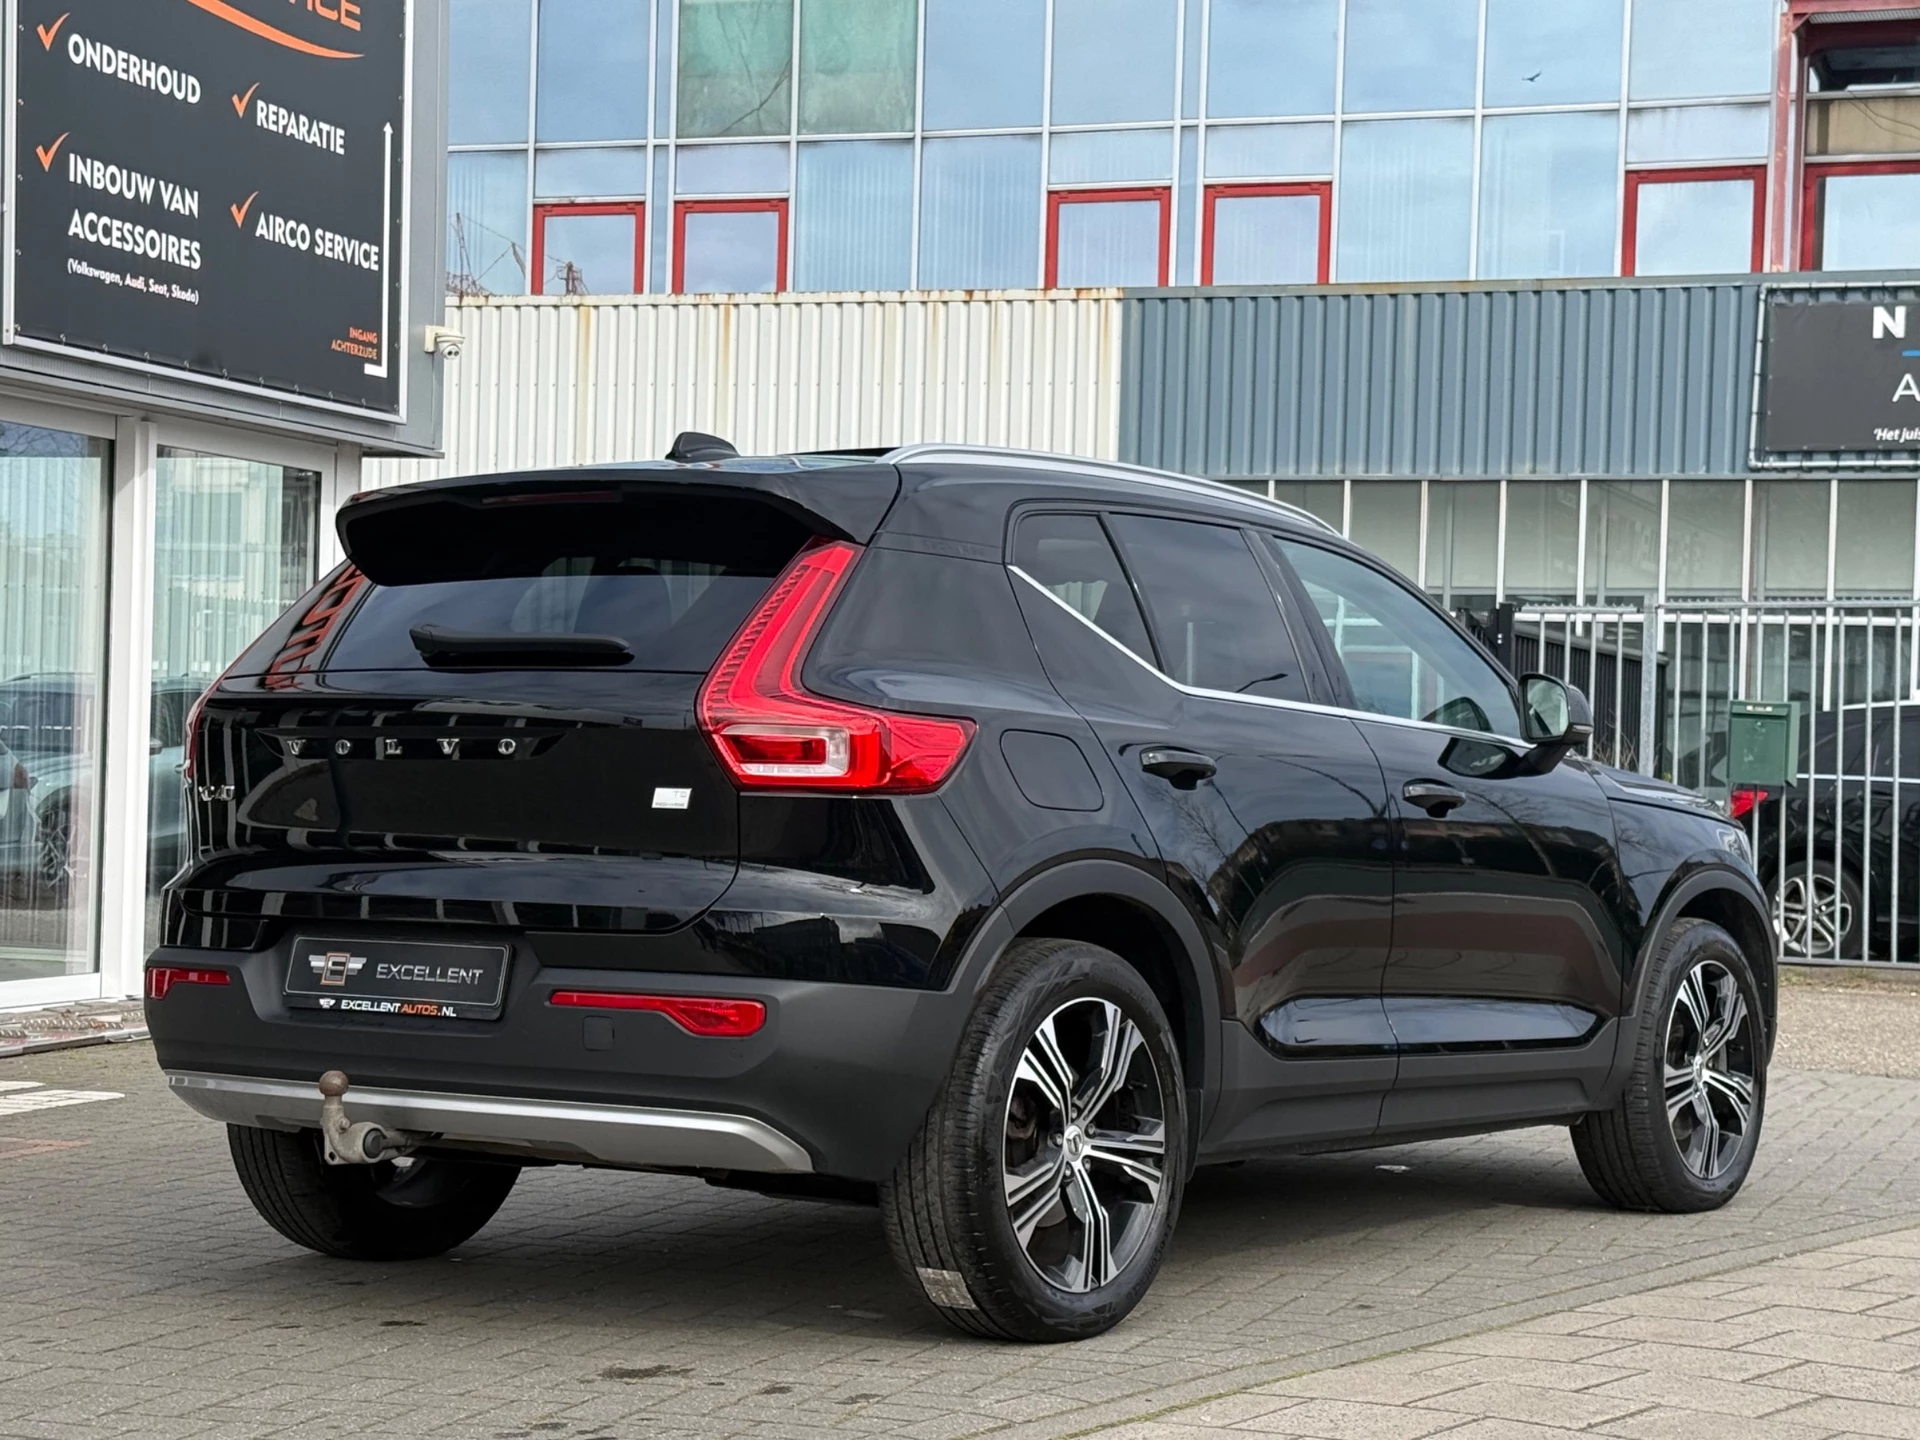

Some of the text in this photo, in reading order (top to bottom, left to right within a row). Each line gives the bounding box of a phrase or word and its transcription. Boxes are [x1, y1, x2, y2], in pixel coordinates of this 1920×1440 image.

[67, 33, 201, 104] ONDERHOUD
[256, 99, 345, 156] REPARATIE
[68, 152, 199, 219] INBOUW VAN
[67, 208, 201, 270] ACCESSOIRES
[254, 211, 380, 271] AIRCO SERVICE
[67, 257, 199, 305] (Volkswagen, Audi, Seat, Skoda)
[349, 326, 378, 345] INGANG
[1872, 305, 1907, 339] N
[286, 738, 517, 756] VOLVO
[376, 963, 484, 985] EXCELLENT
[340, 999, 458, 1018] EXCELLENTAUTOS.NL
